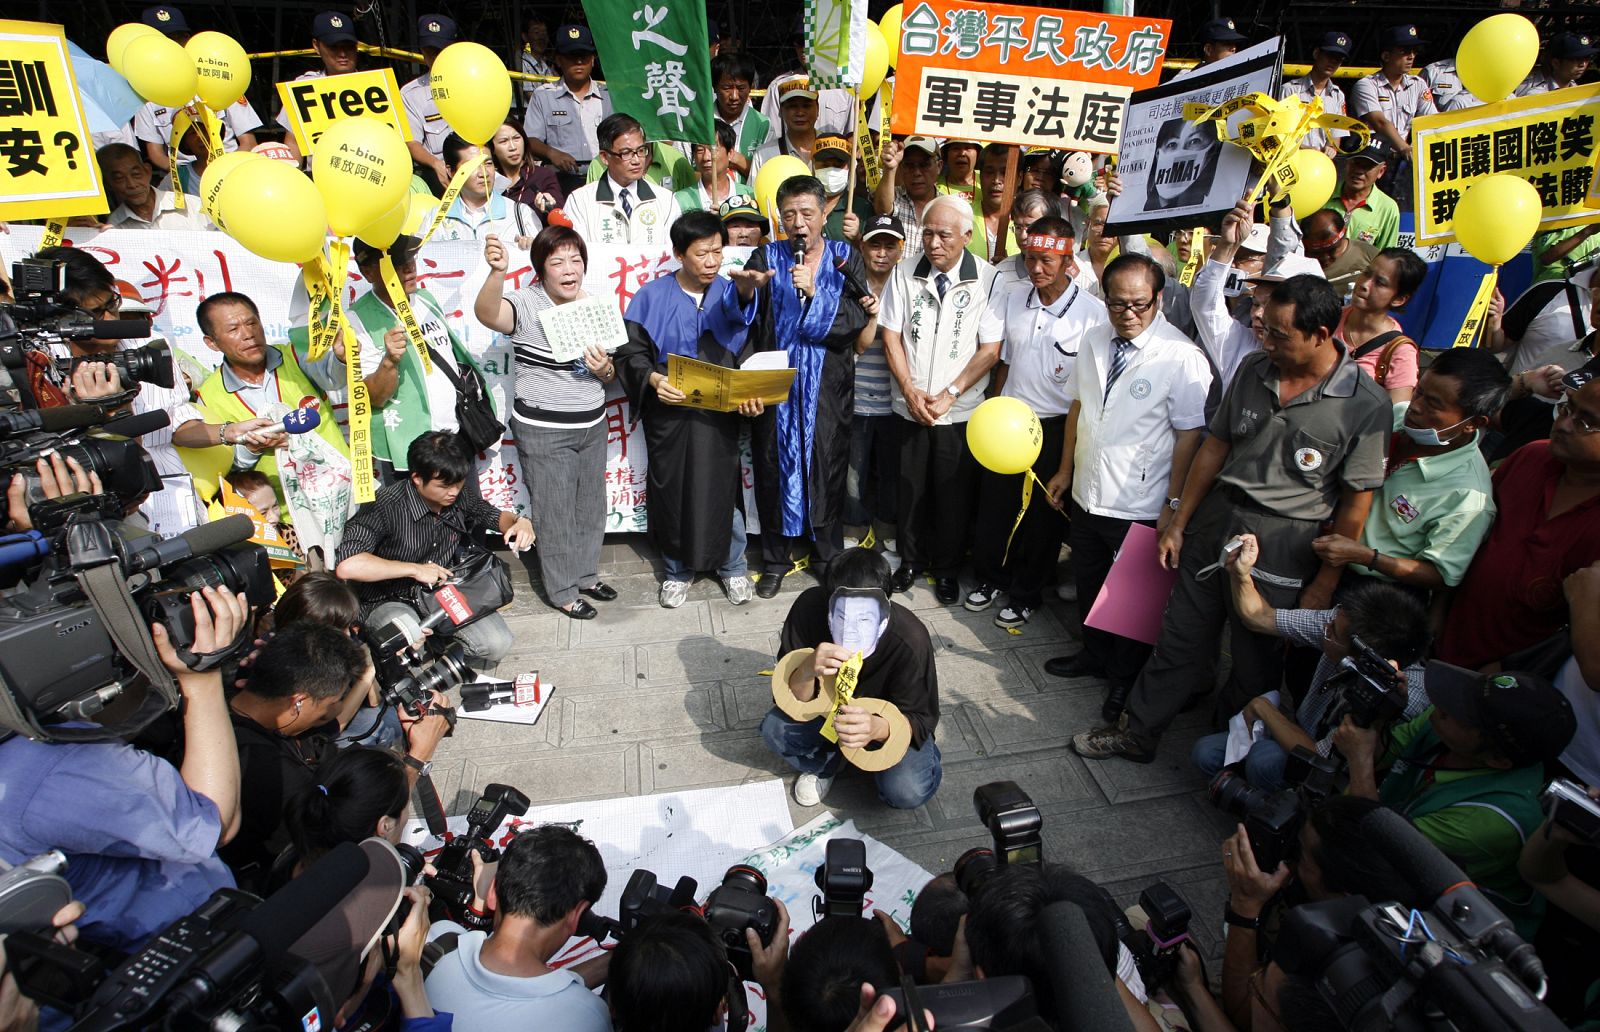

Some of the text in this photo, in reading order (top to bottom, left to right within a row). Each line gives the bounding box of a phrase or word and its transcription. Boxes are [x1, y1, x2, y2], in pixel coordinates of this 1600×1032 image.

[902, 2, 1164, 76] 台灣平民政府
[198, 57, 229, 68] A-bian
[632, 4, 696, 132] 之聲
[292, 84, 389, 124] Free
[922, 75, 1127, 144] 軍事法庭
[1126, 126, 1155, 138] JUDICIAL
[1430, 115, 1594, 184] 別讓國際笑
[329, 155, 387, 187] 釋放阿扁!
[340, 143, 384, 167] A-bian
[1155, 160, 1201, 185] H1MA1
[207, 178, 224, 216] A-bian
[1457, 319, 1478, 344] 釋放
[351, 345, 366, 416] TAIWAN GO GO
[354, 429, 371, 498] 阿扁加油!!
[57, 618, 92, 638] SONY
